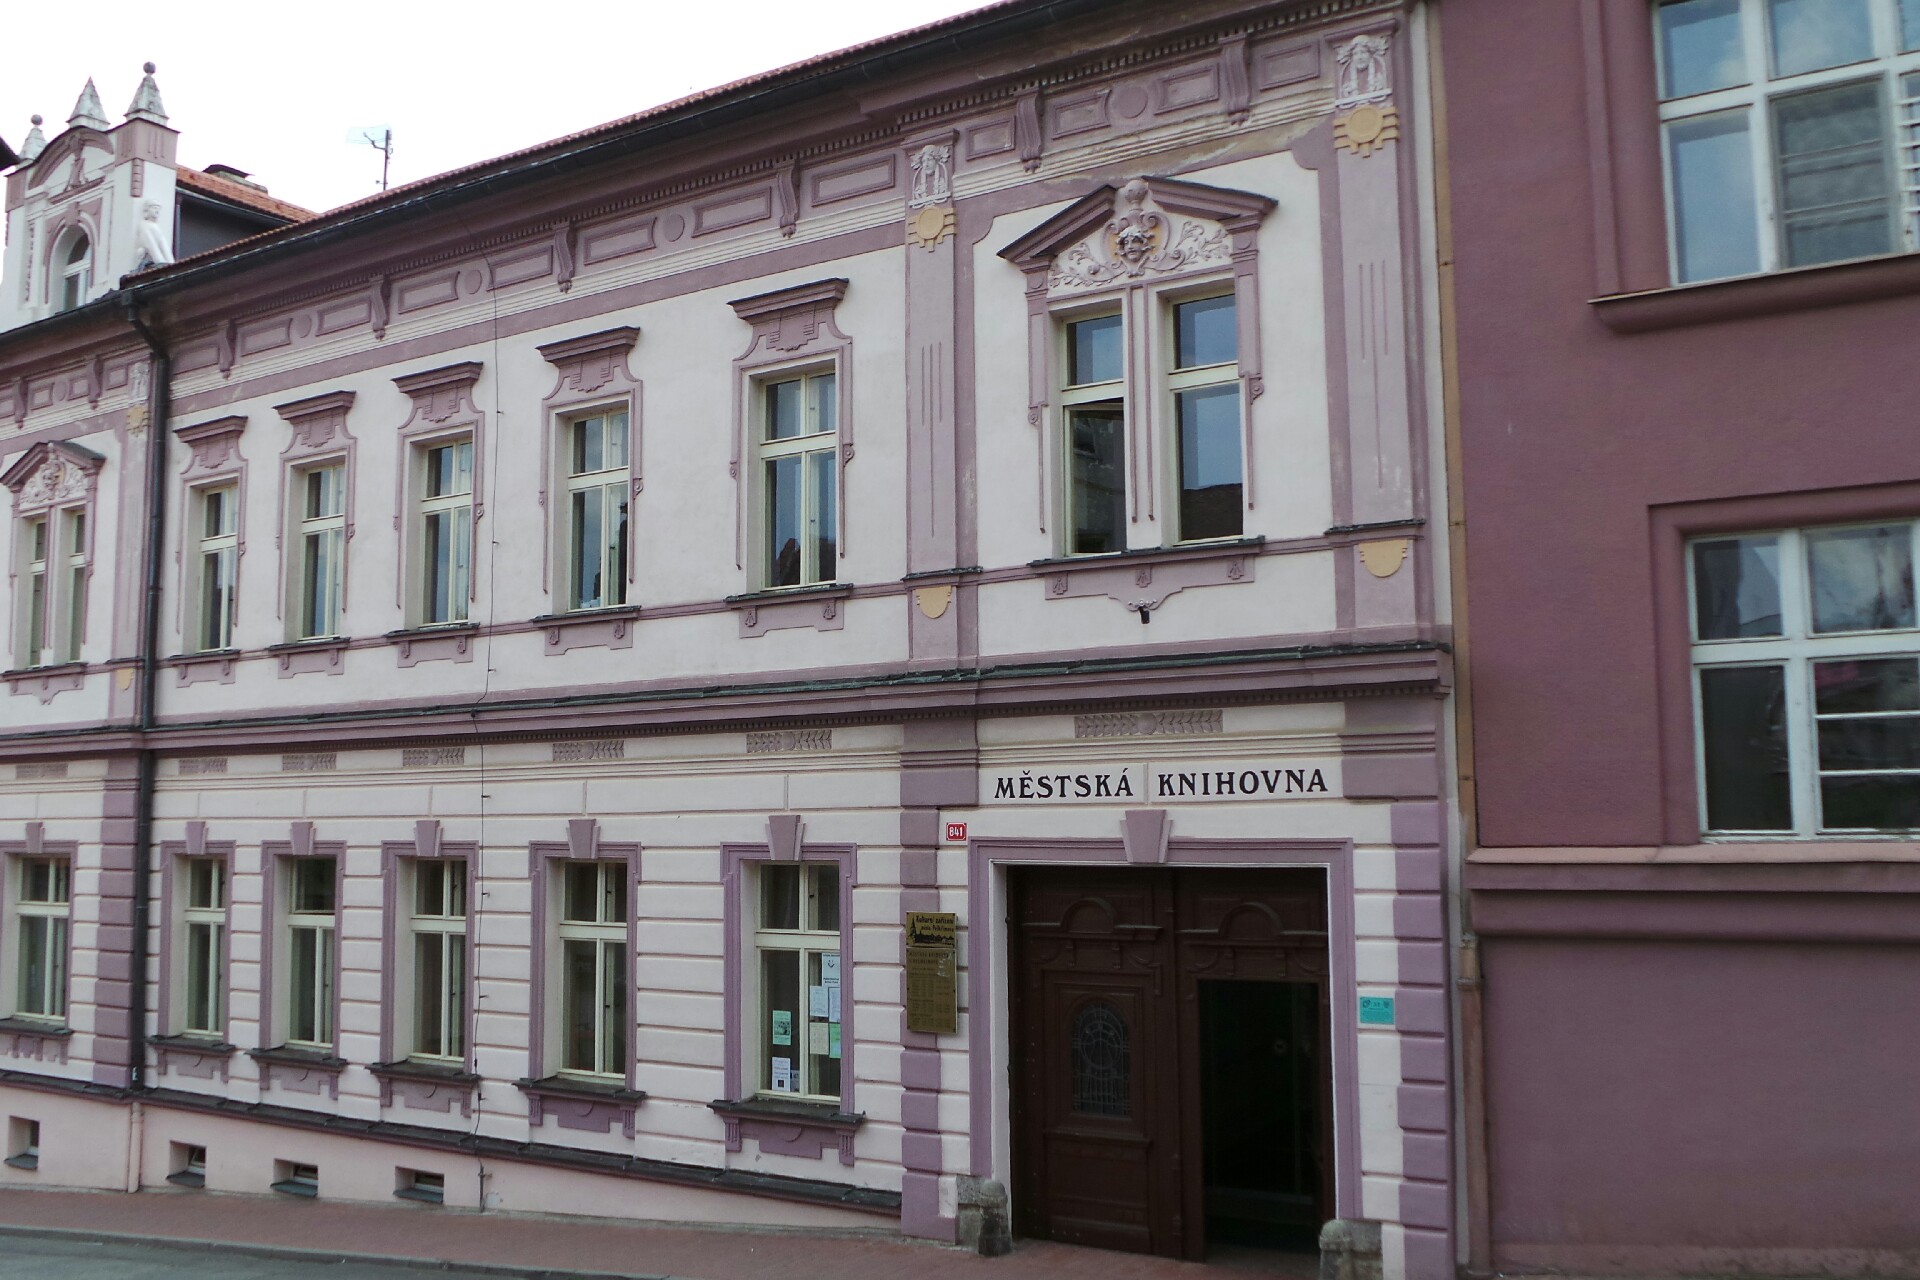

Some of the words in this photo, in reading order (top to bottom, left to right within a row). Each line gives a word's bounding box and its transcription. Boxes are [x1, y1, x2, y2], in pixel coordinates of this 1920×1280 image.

[994, 768, 1134, 799] MĚSTSKÁ
[1157, 768, 1328, 797] KNIHOVNA
[949, 826, 963, 837] 841
